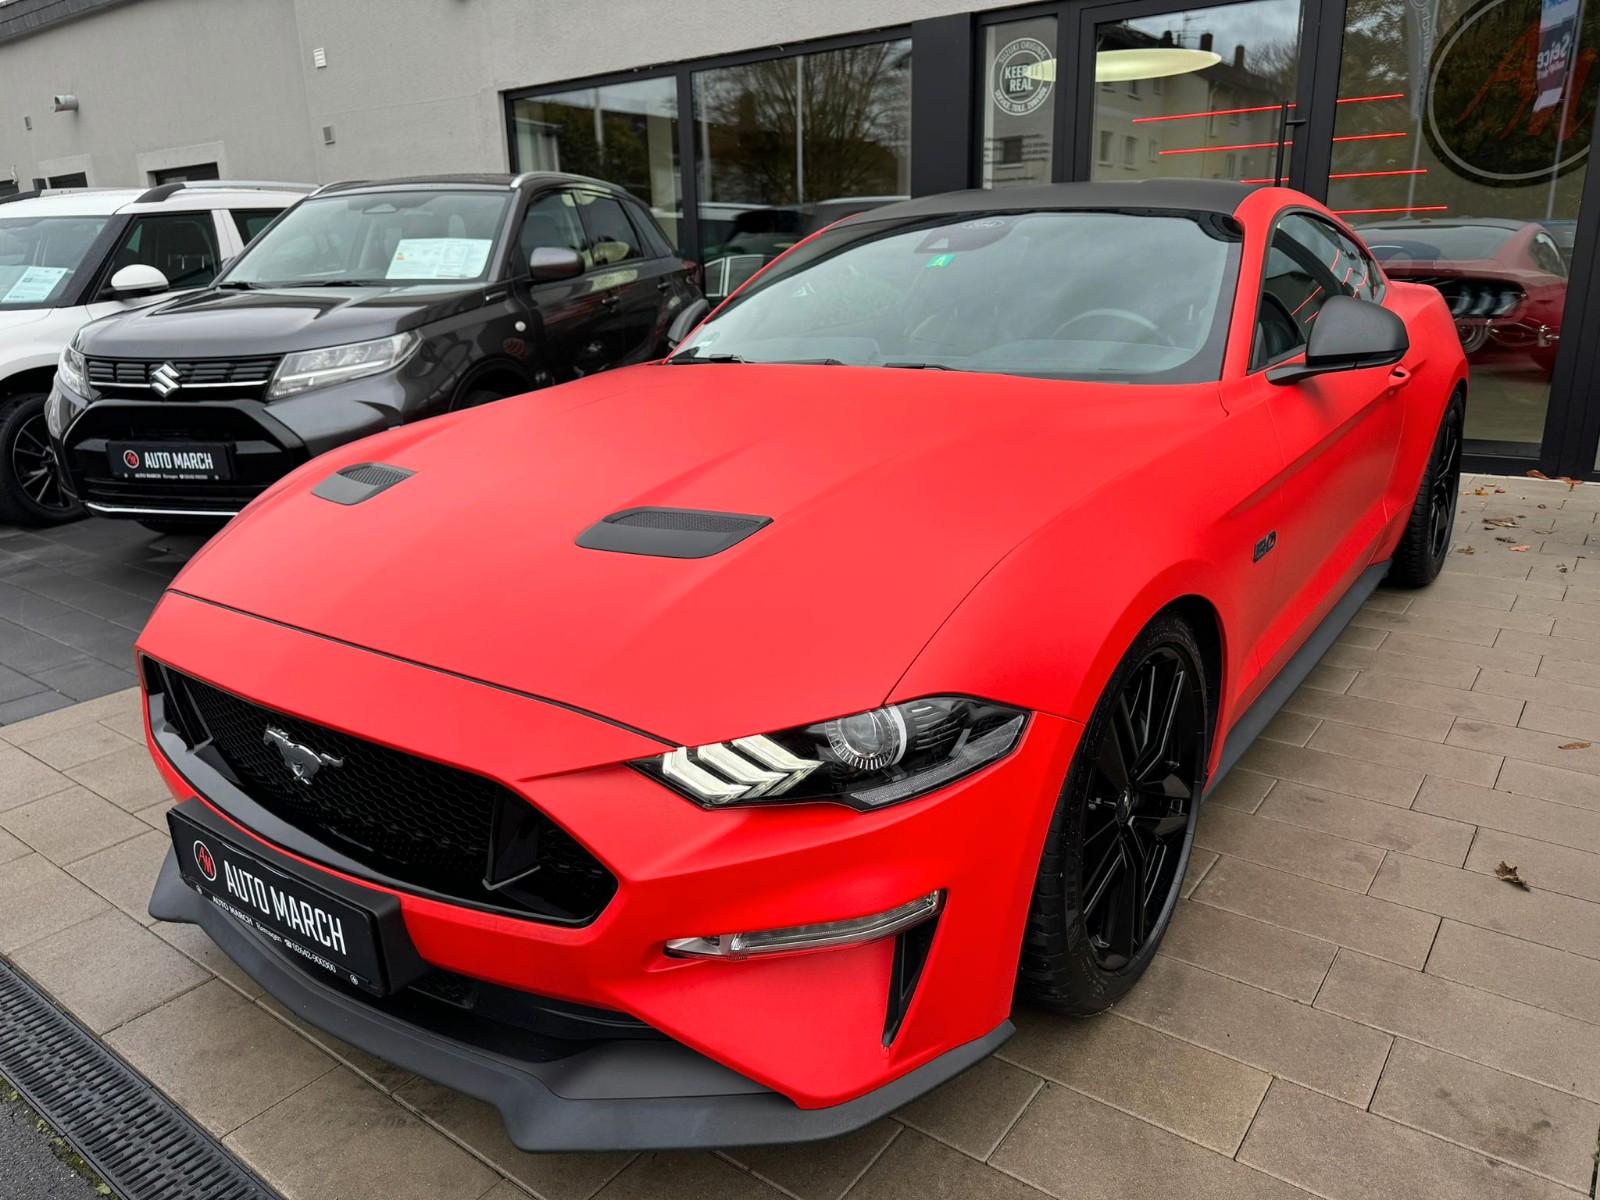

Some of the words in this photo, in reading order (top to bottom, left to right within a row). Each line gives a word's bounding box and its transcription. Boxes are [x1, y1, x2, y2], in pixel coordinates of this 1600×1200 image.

[1009, 78, 1034, 92] REAL
[144, 451, 172, 469] AUTO
[172, 452, 214, 470] MARCH
[223, 860, 271, 915] AUTO
[269, 885, 347, 956] MARCH
